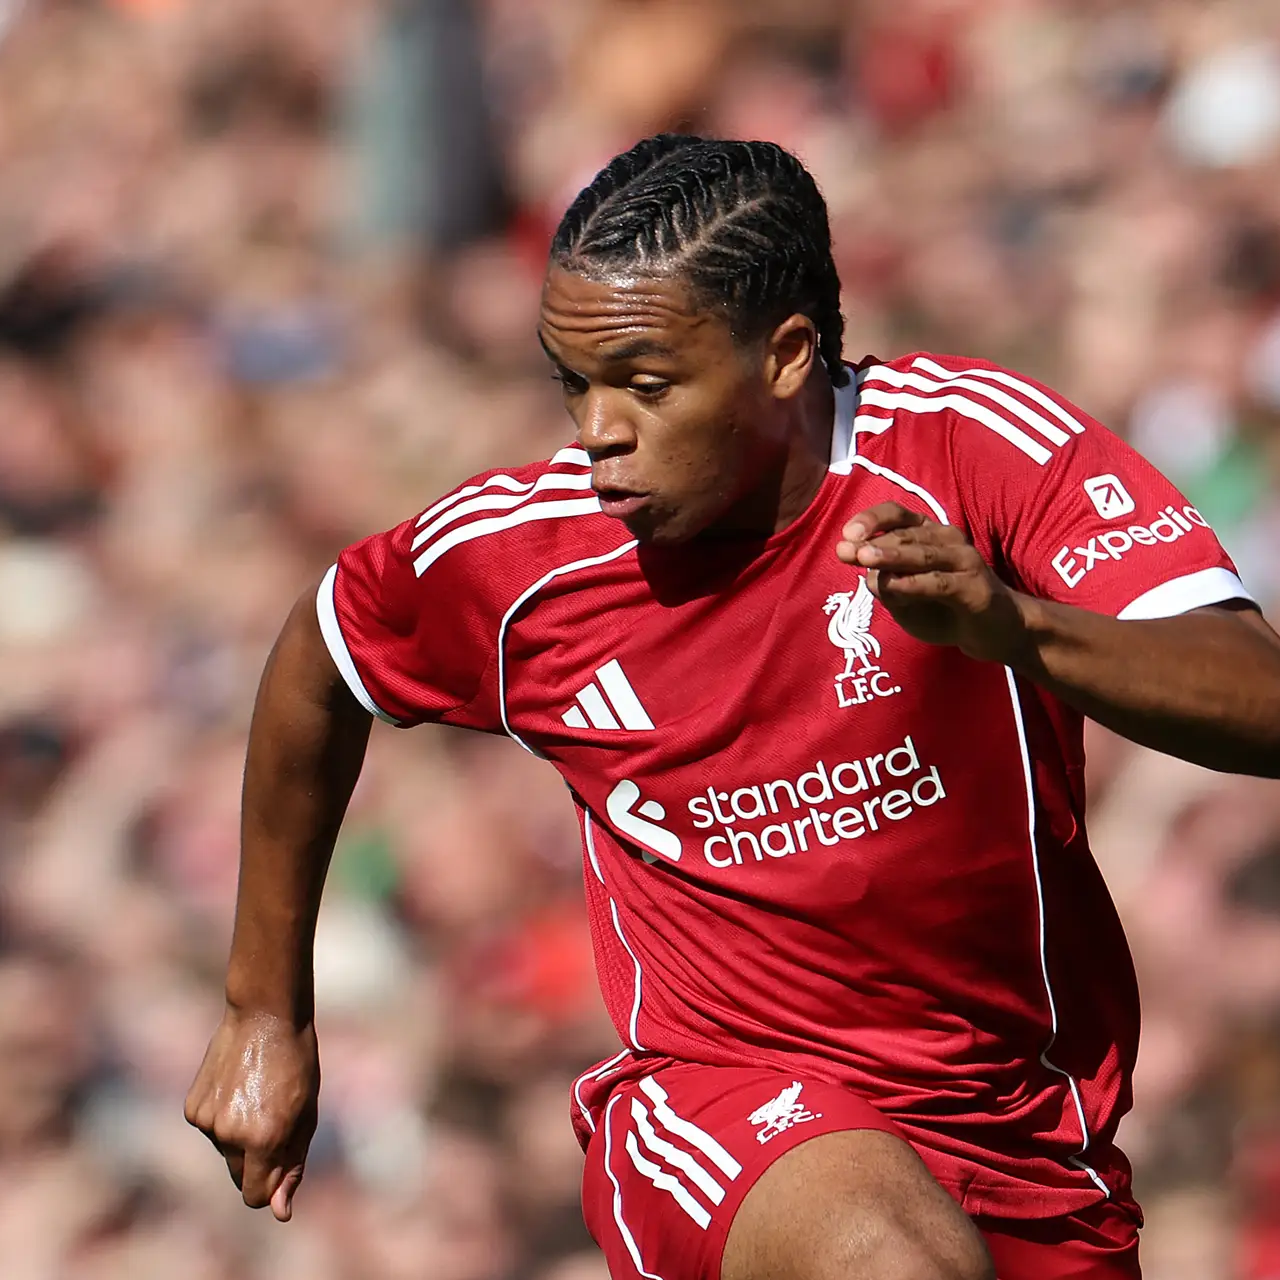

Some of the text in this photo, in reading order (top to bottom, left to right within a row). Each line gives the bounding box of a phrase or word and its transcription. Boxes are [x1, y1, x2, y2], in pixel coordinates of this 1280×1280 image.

[833, 671, 902, 709] L.F.C.
[687, 734, 921, 829] standard
[703, 764, 947, 869] chartered
